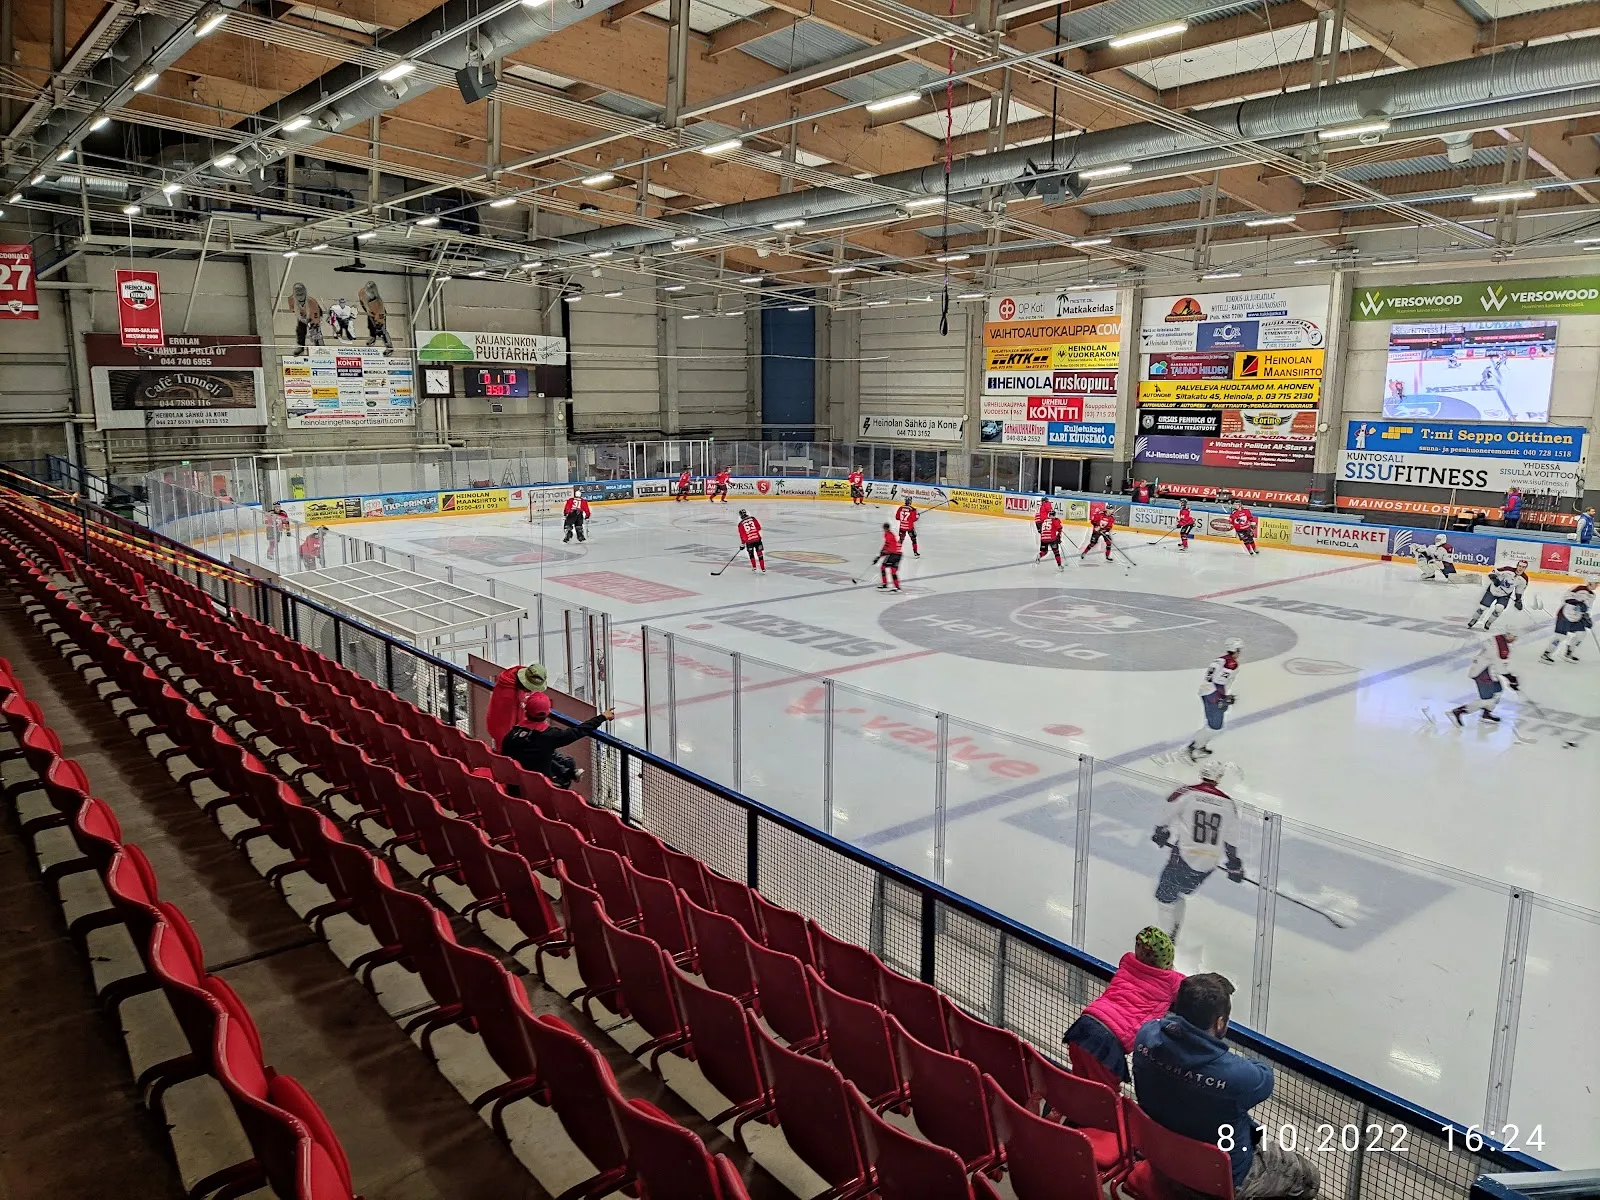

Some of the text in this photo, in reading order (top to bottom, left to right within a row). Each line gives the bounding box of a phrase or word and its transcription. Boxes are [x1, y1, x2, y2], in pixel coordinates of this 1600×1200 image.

[1387, 295, 1463, 308] VERSOWOOD
[1510, 289, 1599, 303] VERSOWOOD
[1019, 302, 1045, 314] OP Koti
[1062, 304, 1114, 315] Matkakeidas
[169, 338, 200, 346] EROLAN
[475, 335, 537, 348] KAIJANSINKON
[476, 346, 538, 362] PUUTARHA
[1006, 353, 1034, 364] KTK
[160, 358, 212, 366] 044 740 6955
[1264, 355, 1312, 365] HEINOLAN
[1200, 366, 1229, 375] HILDEN
[1263, 367, 1322, 377] MAANSIIRTO
[145, 373, 223, 398] Café Tunneli
[997, 377, 1052, 389] HEINOLA
[1277, 383, 1315, 391] AHONEN
[1029, 406, 1079, 421] KONTTI
[873, 418, 957, 432] Heinolan Sähkö ja Kone
[1064, 425, 1105, 434] Kuljetukset
[1049, 433, 1067, 442] KARI
[1071, 434, 1107, 444] KUUSEMO
[1420, 428, 1573, 445] T:mi Seppo Oittinen
[1146, 452, 1200, 462] KJ-Ilmastointi Oy
[1346, 452, 1404, 463] KUNTOSALI
[1450, 447, 1520, 456] pesuhuoneremontit
[1554, 450, 1572, 458] 1518
[1500, 468, 1532, 476] SISULLA
[1523, 462, 1561, 471] YHDESSÄ
[1344, 462, 1488, 488] SISUFITNESS
[1510, 479, 1569, 487] www.sisufitness.fi
[952, 490, 1003, 500] RAKENNUSPALVELU
[1203, 488, 1261, 499] SAAAAN
[1265, 491, 1310, 503] PITKÄN
[384, 497, 437, 511] TKP-PRINT.FI
[572, 500, 582, 509] 31
[1135, 513, 1203, 529] SISUFITS
[1262, 521, 1289, 530] Heinolan
[1260, 528, 1291, 542] Leka Oy
[1303, 525, 1386, 543] CITYMARKET
[1316, 538, 1359, 549] HEINOLA
[1476, 554, 1490, 564] Oy
[902, 613, 1110, 662] Heinola
[1193, 809, 1222, 846] 89
